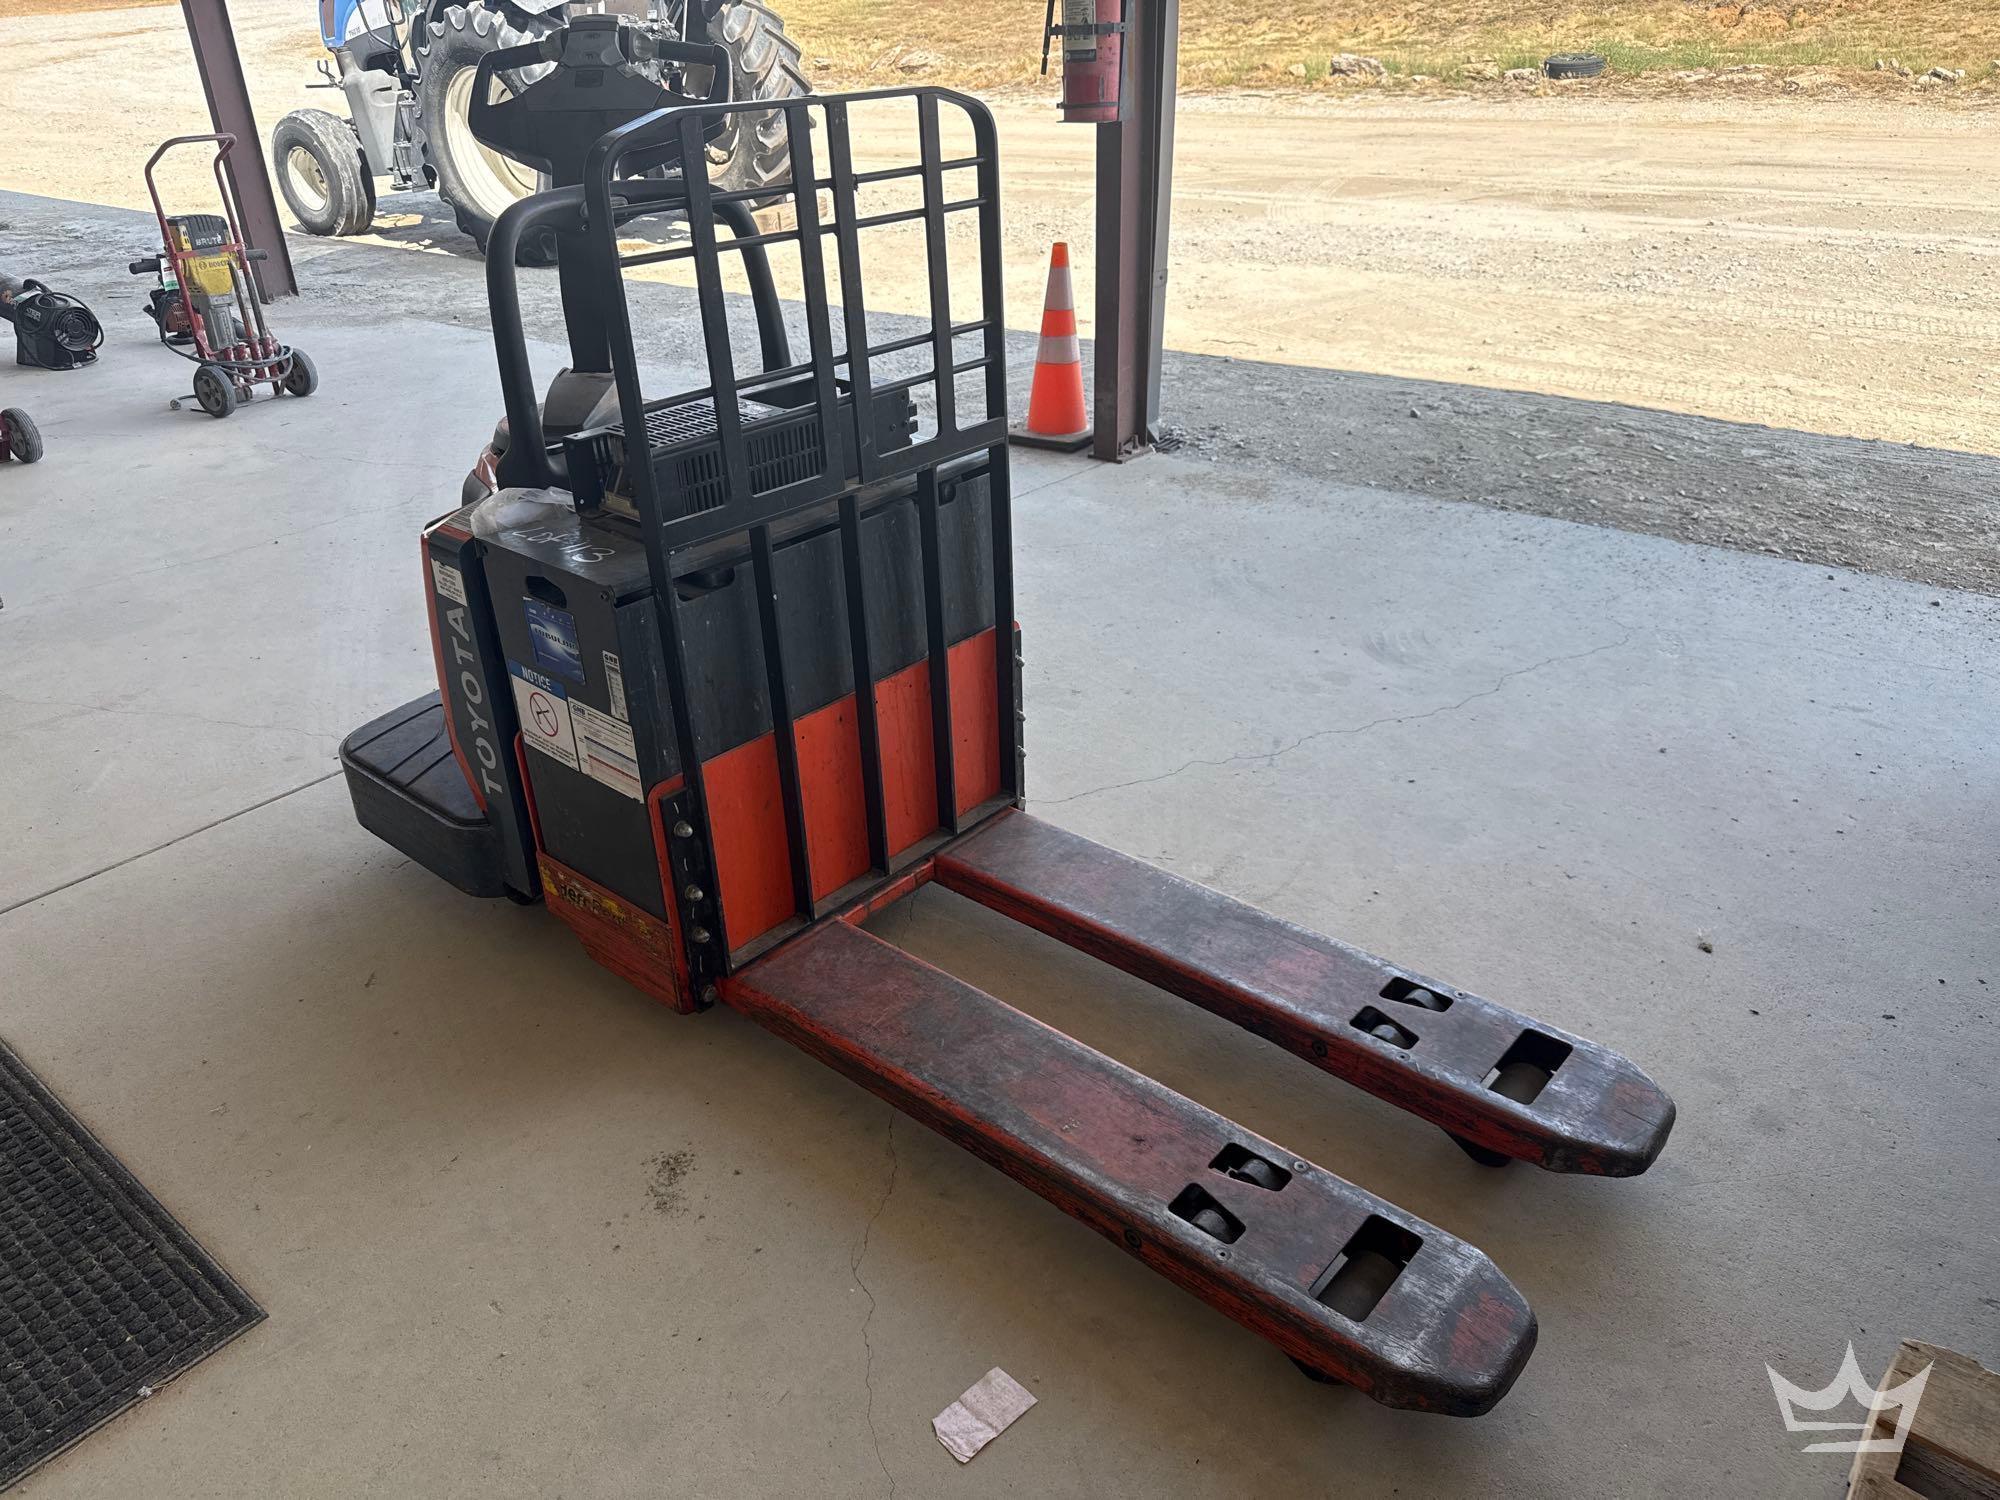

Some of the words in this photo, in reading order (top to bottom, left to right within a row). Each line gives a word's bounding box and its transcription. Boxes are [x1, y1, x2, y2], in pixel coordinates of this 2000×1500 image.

[196, 235, 222, 246] BRUTE
[561, 541, 615, 563] 113
[521, 665, 552, 691] NOTICE
[446, 606, 503, 794] TOYOTA
